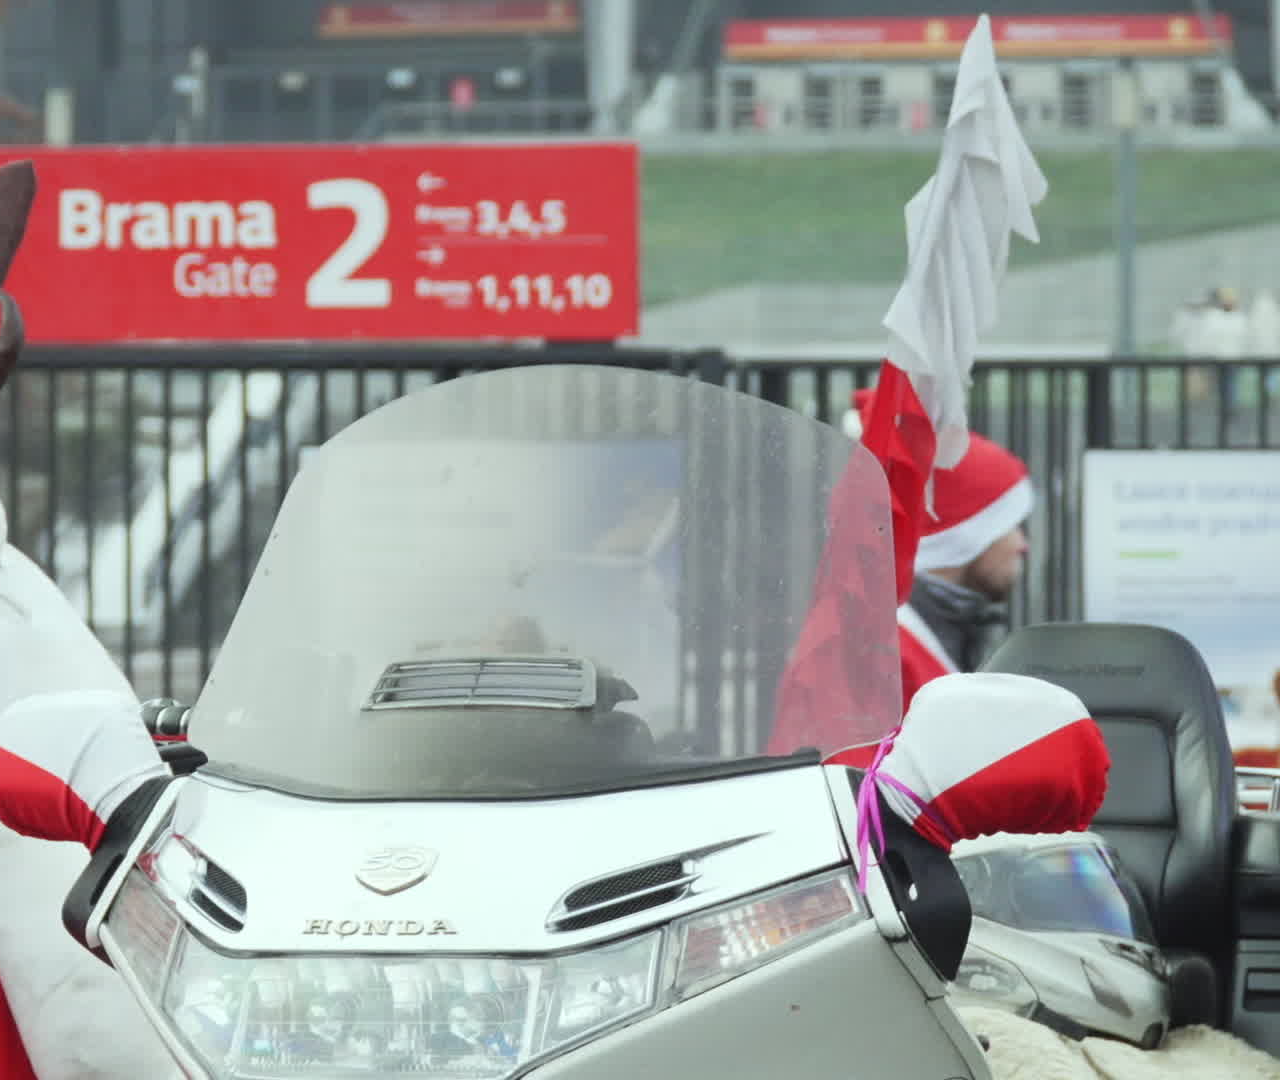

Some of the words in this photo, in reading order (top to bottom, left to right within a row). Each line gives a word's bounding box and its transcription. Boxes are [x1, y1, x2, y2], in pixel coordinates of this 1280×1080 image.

[58, 189, 278, 249] Brama
[476, 199, 567, 239] 3,4,5
[305, 178, 392, 309] 2
[173, 252, 278, 298] Gate
[476, 273, 612, 314] 1,11,10
[303, 919, 457, 936] HONDA
